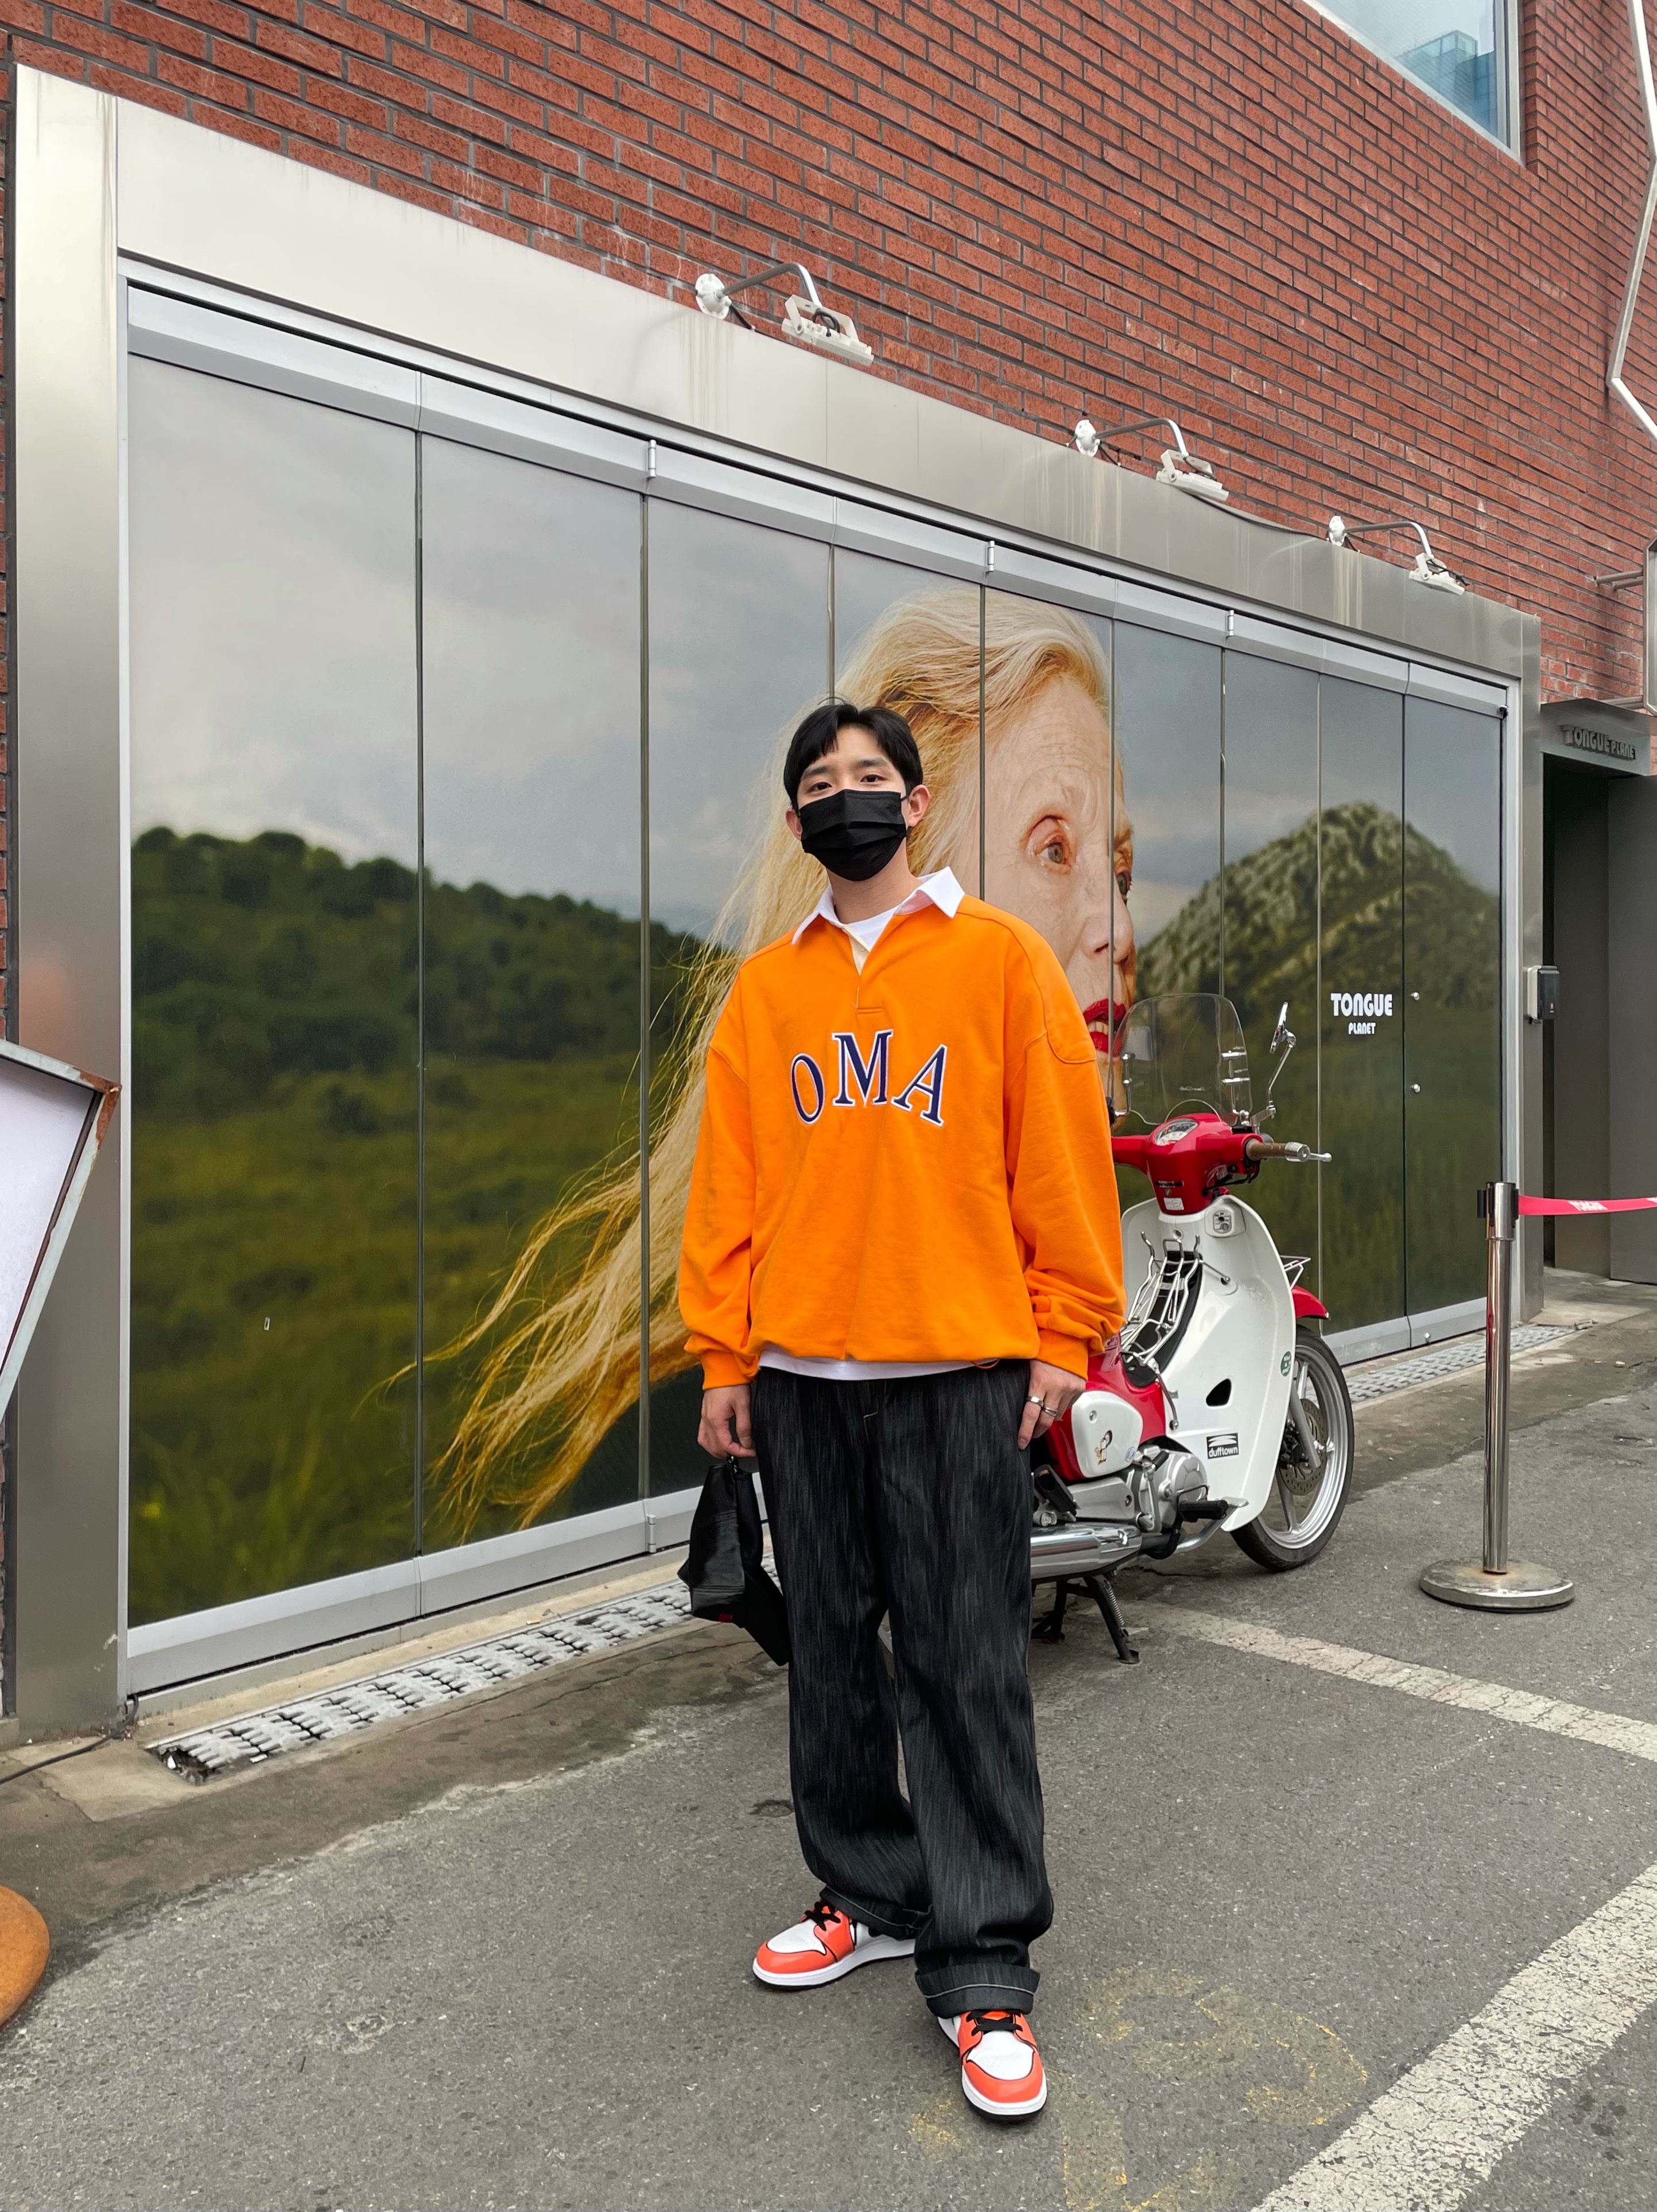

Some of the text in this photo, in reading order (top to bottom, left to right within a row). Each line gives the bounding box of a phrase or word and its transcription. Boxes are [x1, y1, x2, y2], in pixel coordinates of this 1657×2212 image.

[1561, 725, 1609, 752] TONGUE
[1330, 993, 1393, 1017] TONGUE
[1348, 1022, 1376, 1035] PLANET
[791, 1029, 948, 1128] OMA
[1208, 1447, 1238, 1457] dufftown
